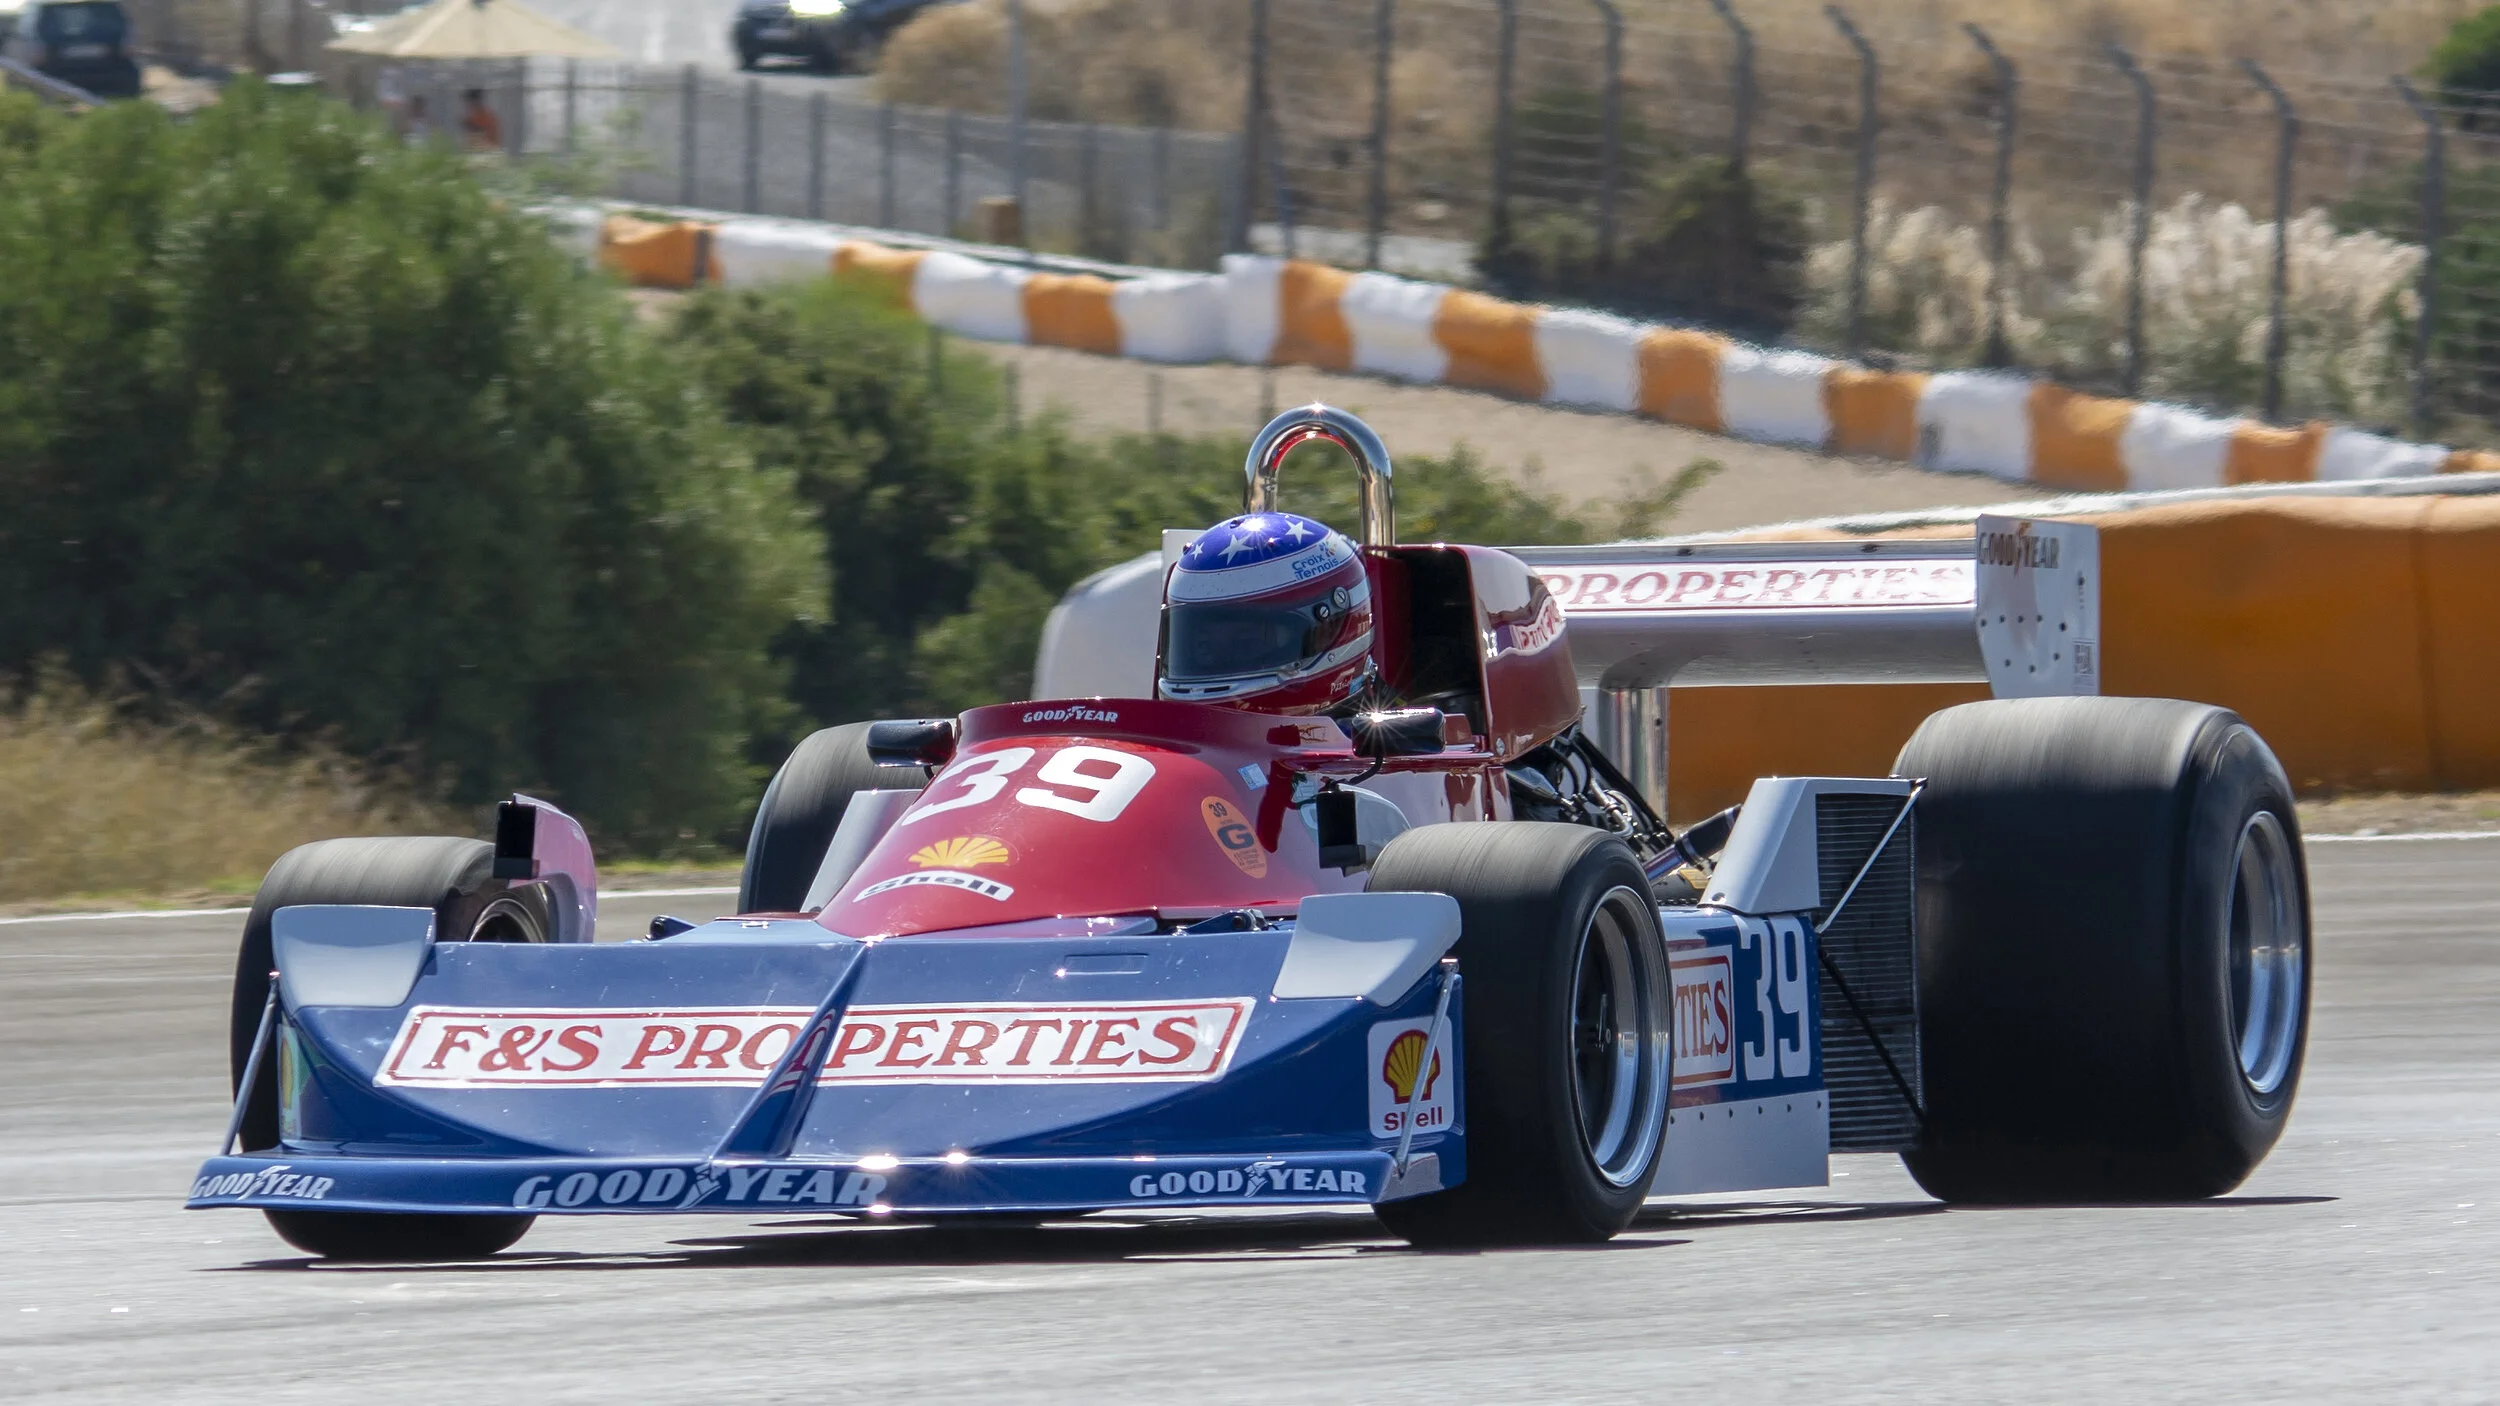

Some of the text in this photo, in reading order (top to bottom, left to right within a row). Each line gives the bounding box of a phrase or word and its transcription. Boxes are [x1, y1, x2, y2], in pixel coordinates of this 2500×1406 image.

[1292, 554, 1325, 571] Croix
[1294, 558, 1339, 580] Ternois
[900, 746, 1156, 823] 39
[1208, 802, 1228, 818] 39
[1217, 824, 1255, 850] G
[863, 876, 1001, 897] Shell
[1731, 914, 1811, 1081] 39
[421, 1015, 1201, 1073] F&S PROPERTIES
